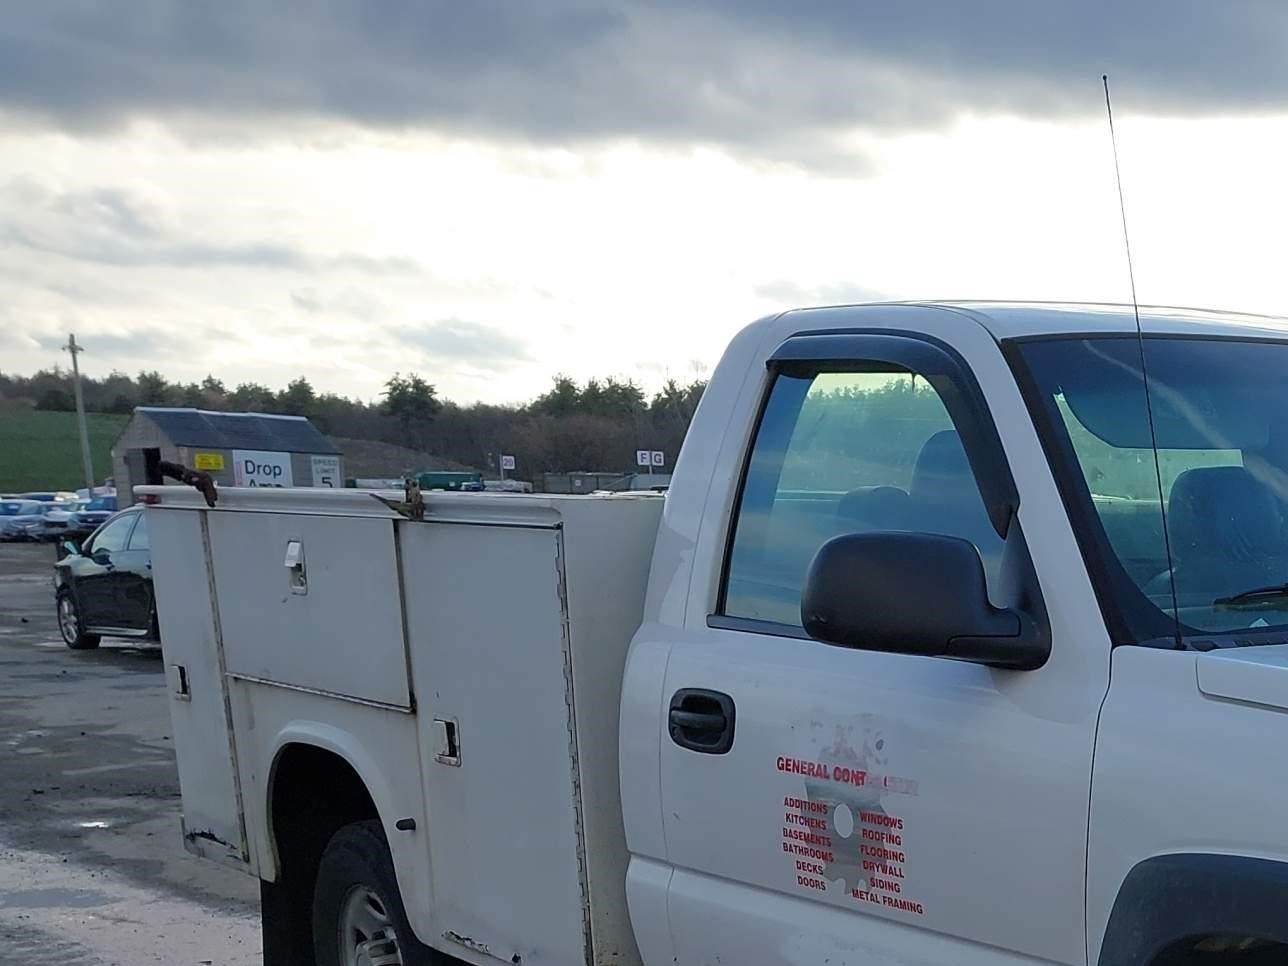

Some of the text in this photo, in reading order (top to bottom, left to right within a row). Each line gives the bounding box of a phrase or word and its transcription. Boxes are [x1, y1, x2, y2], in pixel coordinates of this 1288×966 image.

[641, 453, 662, 464] F G
[244, 460, 282, 478] Drop
[776, 756, 830, 780] GENERAL
[784, 796, 828, 815] ADDITIONS
[785, 812, 827, 831] KITCHENS
[859, 811, 903, 830] WINDOWS
[783, 827, 832, 847] BASEMENTS
[862, 828, 901, 846] ROOFING
[783, 842, 834, 862] BATHROOMS
[860, 844, 905, 863] FLOORING
[796, 860, 824, 875] DECKS
[863, 860, 905, 878] DRYWALL
[797, 875, 826, 891] DOORS
[870, 877, 901, 893] SIDING
[852, 887, 923, 914] METAL FRAMING
